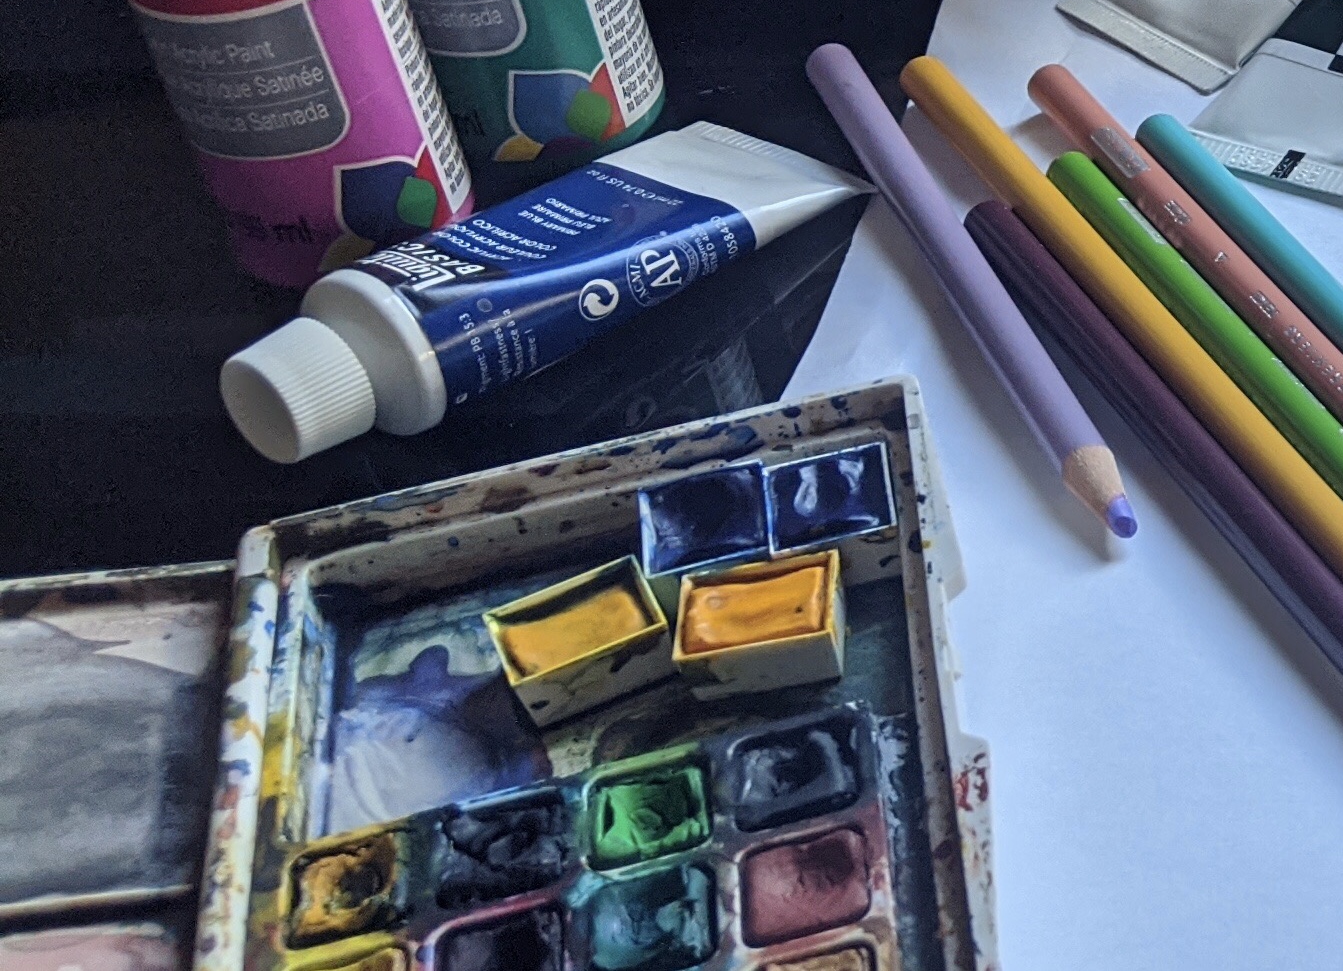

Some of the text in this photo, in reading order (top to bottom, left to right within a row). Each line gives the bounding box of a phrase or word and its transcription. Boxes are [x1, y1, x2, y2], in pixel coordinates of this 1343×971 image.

[225, 40, 275, 64] Paint
[257, 65, 323, 96] Satinée
[251, 102, 329, 131] Satinada
[517, 209, 544, 223] BLUE
[638, 244, 683, 290] AP
[470, 336, 483, 351] PB
